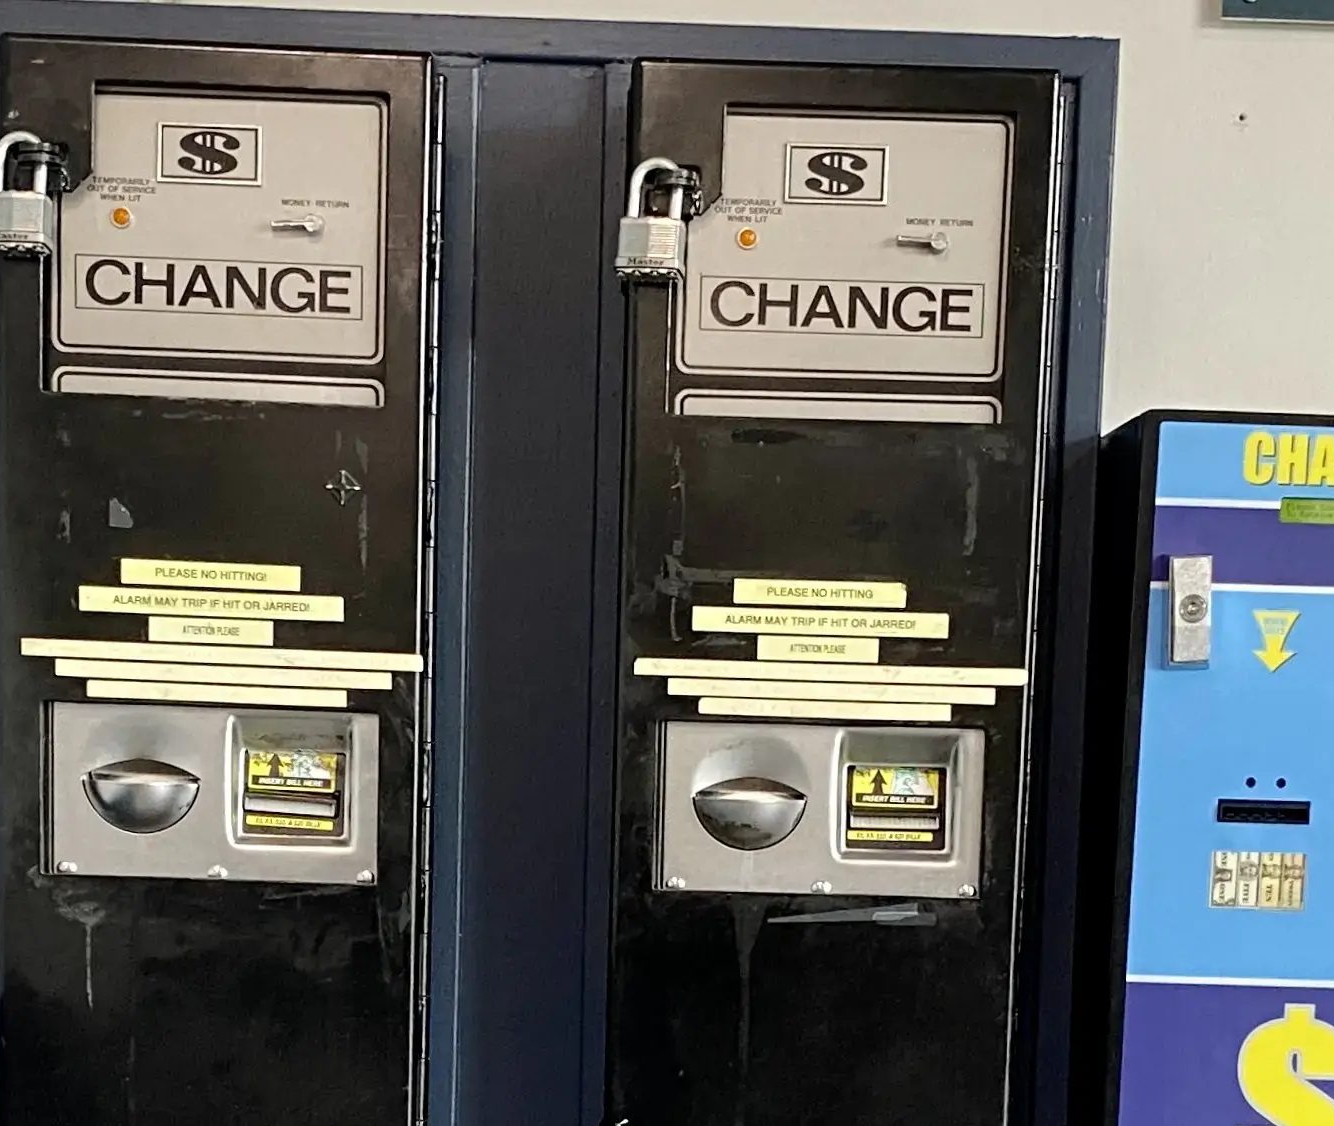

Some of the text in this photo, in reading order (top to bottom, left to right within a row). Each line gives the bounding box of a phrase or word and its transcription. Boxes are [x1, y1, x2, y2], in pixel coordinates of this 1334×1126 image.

[87, 184, 104, 192] OUT
[122, 186, 156, 194] SERVICE
[100, 193, 125, 201] WHEN
[281, 199, 349, 208] MONEY RETURN
[714, 204, 782, 215] OUT OF SERVICE
[906, 218, 973, 227] MONEY RETURN
[627, 256, 664, 265] Master
[85, 258, 352, 314] CHANGE
[710, 280, 974, 332] CHANGE
[155, 567, 267, 582] PLEASE NO HITTING!
[767, 587, 874, 600] PLEASE NO HITTING
[113, 594, 310, 613] ALARM MAY TRIP IF HIT OR JARRED!
[725, 614, 916, 630] ALARM MAY TRIP IF HIT OR JARRED!
[182, 624, 240, 637] ATTENTION PLEASE
[790, 643, 846, 655] ATTENTION PLEASE
[286, 778, 302, 786] BILL
[862, 795, 889, 803] INSERT
[889, 795, 905, 803] BILL
